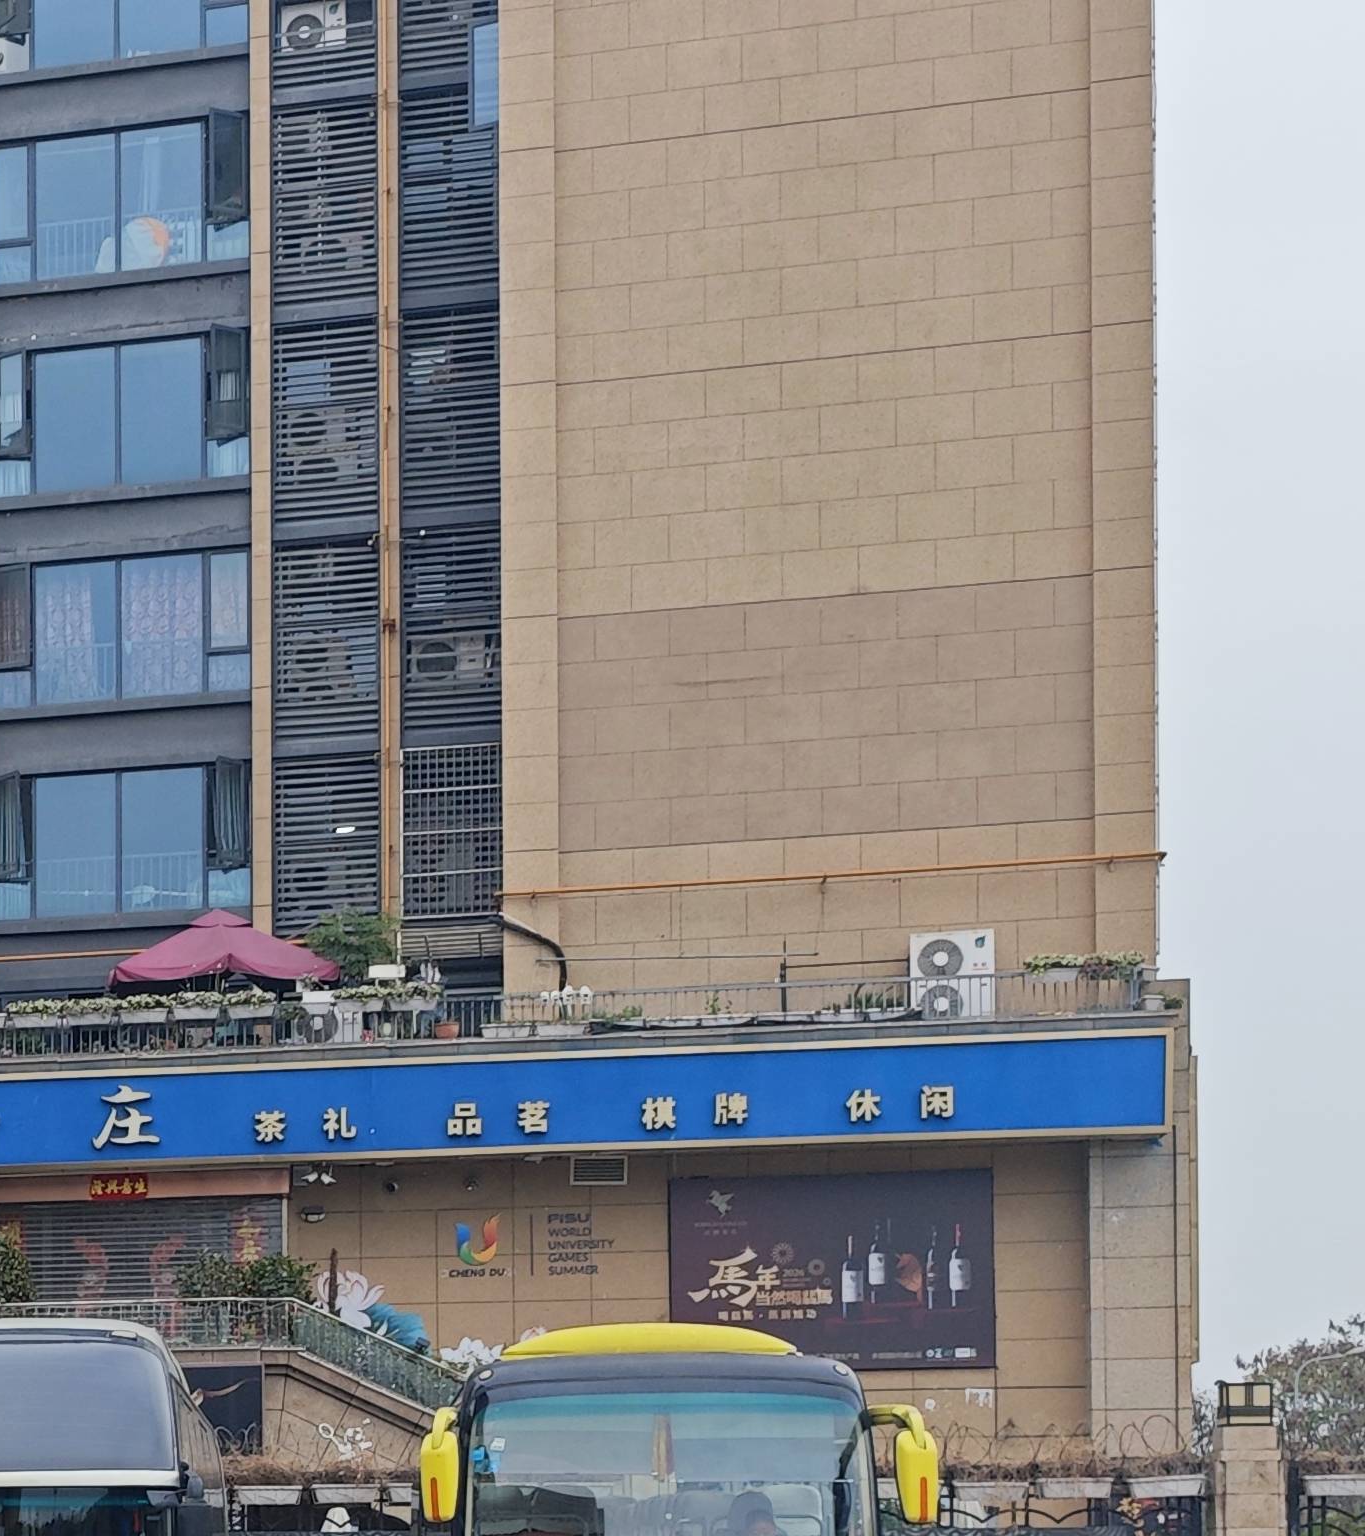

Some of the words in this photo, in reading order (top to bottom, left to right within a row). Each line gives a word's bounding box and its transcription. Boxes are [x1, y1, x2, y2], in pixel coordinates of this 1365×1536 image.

[254, 1107, 357, 1142] 茶礼
[447, 1101, 550, 1136] 品茗
[641, 1092, 748, 1131] 棋牌
[846, 1085, 954, 1122] 休闲
[548, 1227, 591, 1237] WORLD
[548, 1240, 615, 1250] UNIVERSITY
[548, 1252, 589, 1262] GAMES
[448, 1269, 486, 1278] CHENG
[489, 1268, 505, 1277] DU
[548, 1265, 598, 1275] SUMMER
